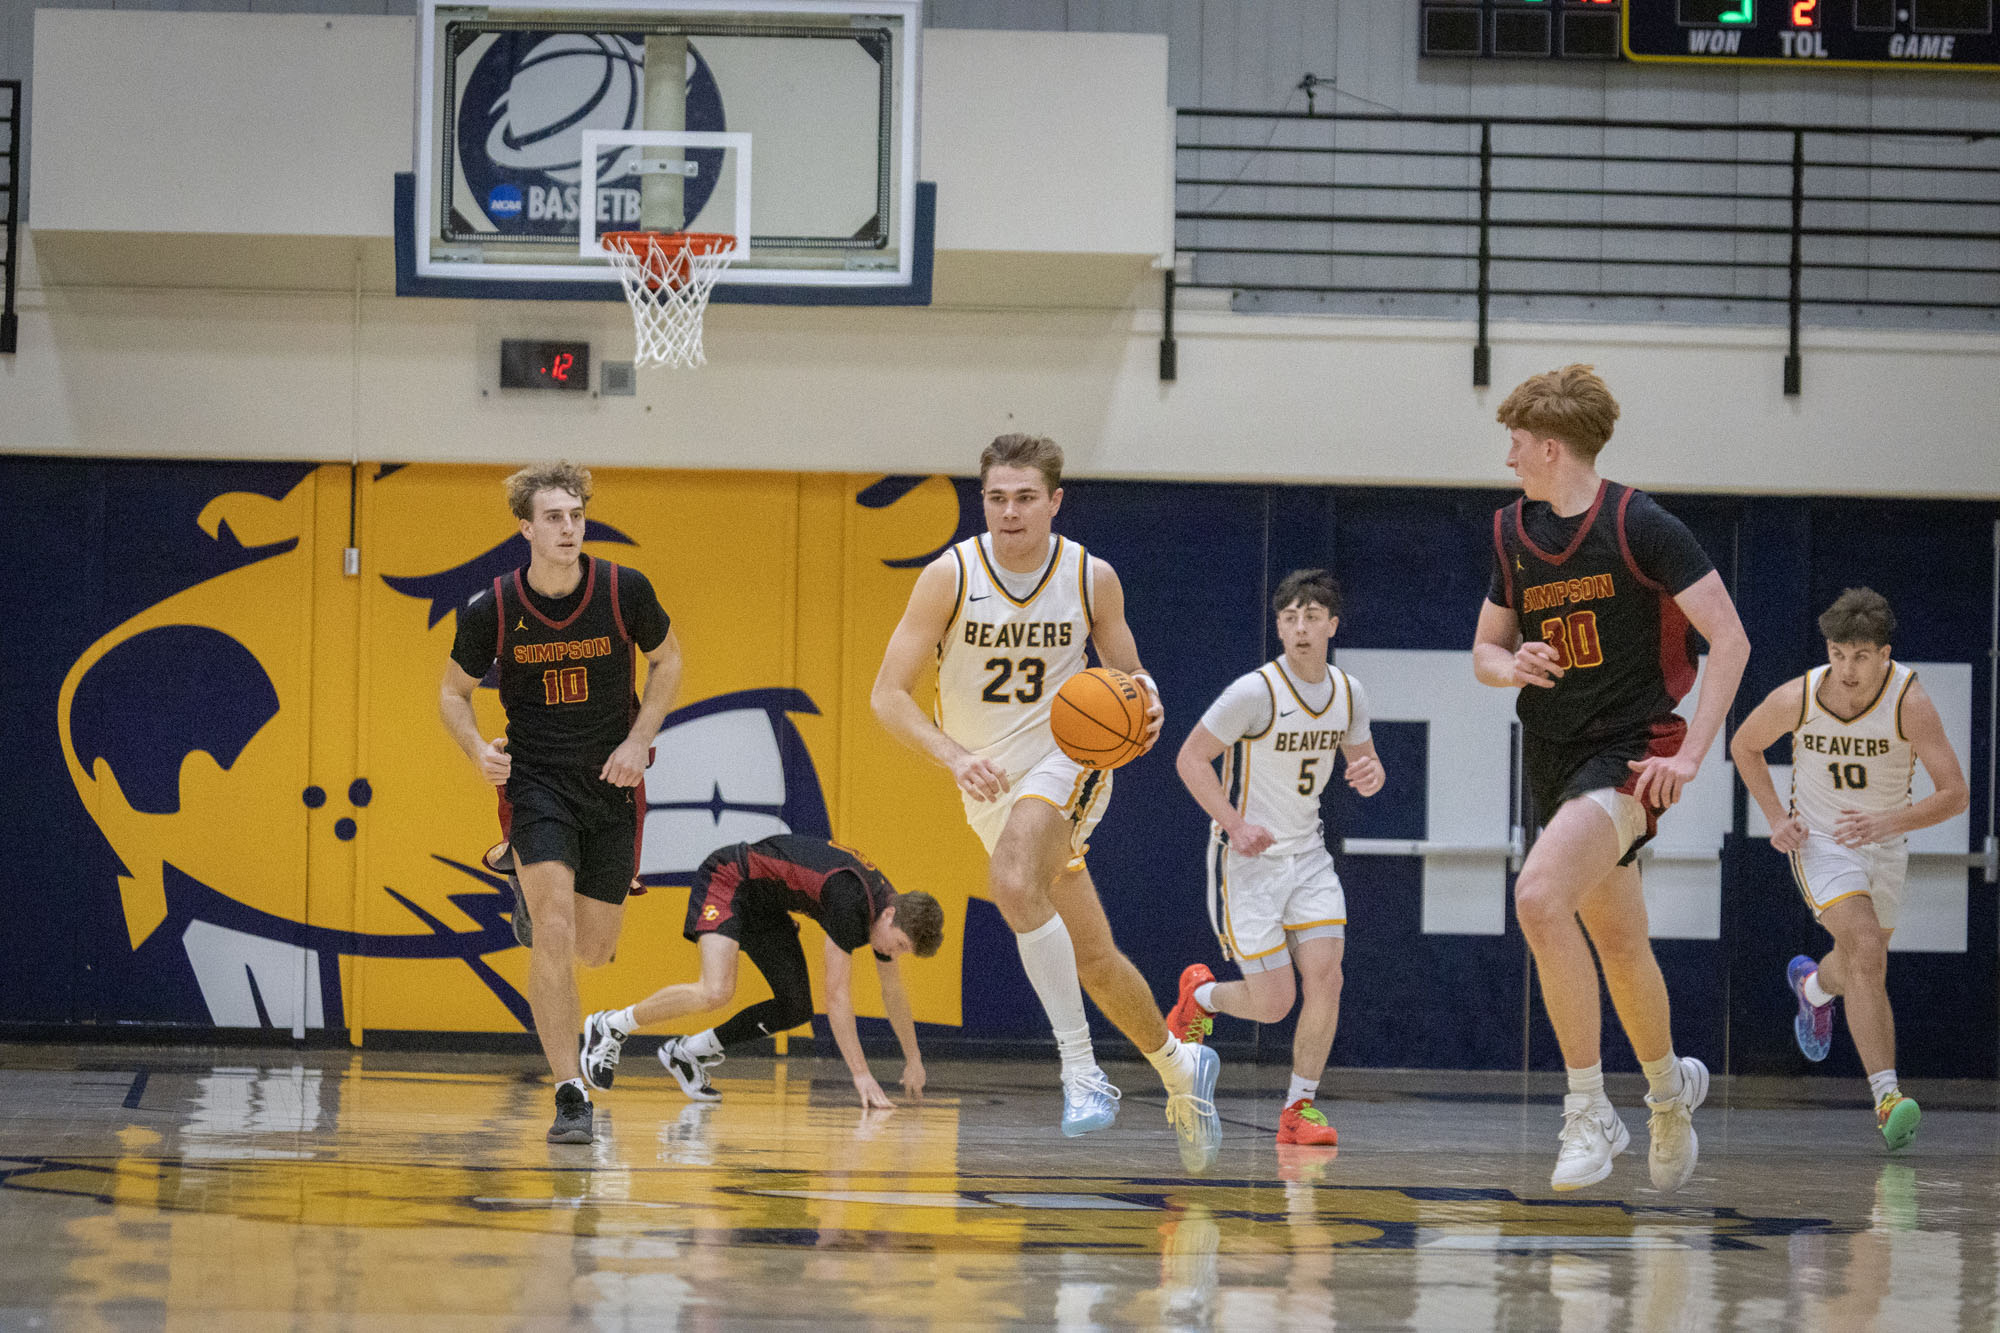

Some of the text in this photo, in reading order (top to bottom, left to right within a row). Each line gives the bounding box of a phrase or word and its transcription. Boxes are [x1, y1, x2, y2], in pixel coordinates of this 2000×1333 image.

[1688, 29, 1956, 59] WON TOL GAME
[490, 185, 641, 223] NCAA BASETB
[514, 636, 611, 663] SIMPSON
[964, 620, 1073, 647] BEAVERS
[1541, 610, 1604, 670] 30
[542, 666, 588, 705] 10
[982, 656, 1047, 704] 23
[1803, 734, 1890, 757] BEAVERS
[1297, 757, 1320, 796] 5
[1828, 762, 1868, 790] 10
